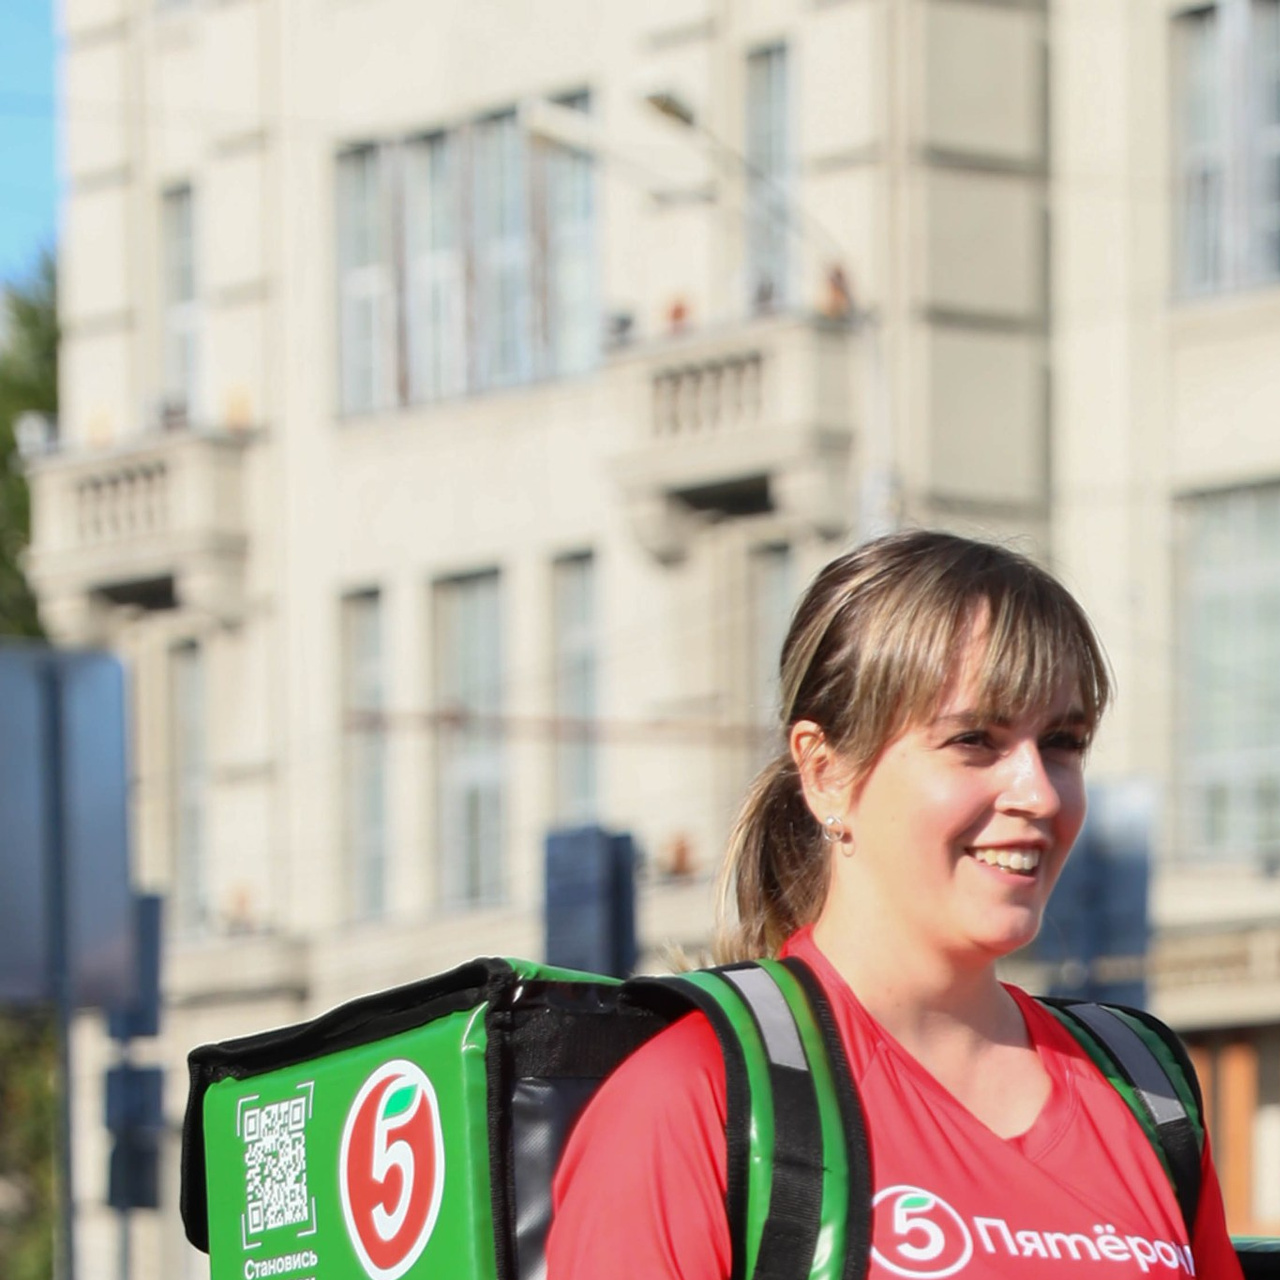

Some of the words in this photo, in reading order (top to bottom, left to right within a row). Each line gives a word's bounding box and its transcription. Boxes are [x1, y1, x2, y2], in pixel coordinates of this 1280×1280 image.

[371, 1074, 424, 1242] 5
[893, 1192, 946, 1261] 5
[244, 1249, 318, 1280] Становись
